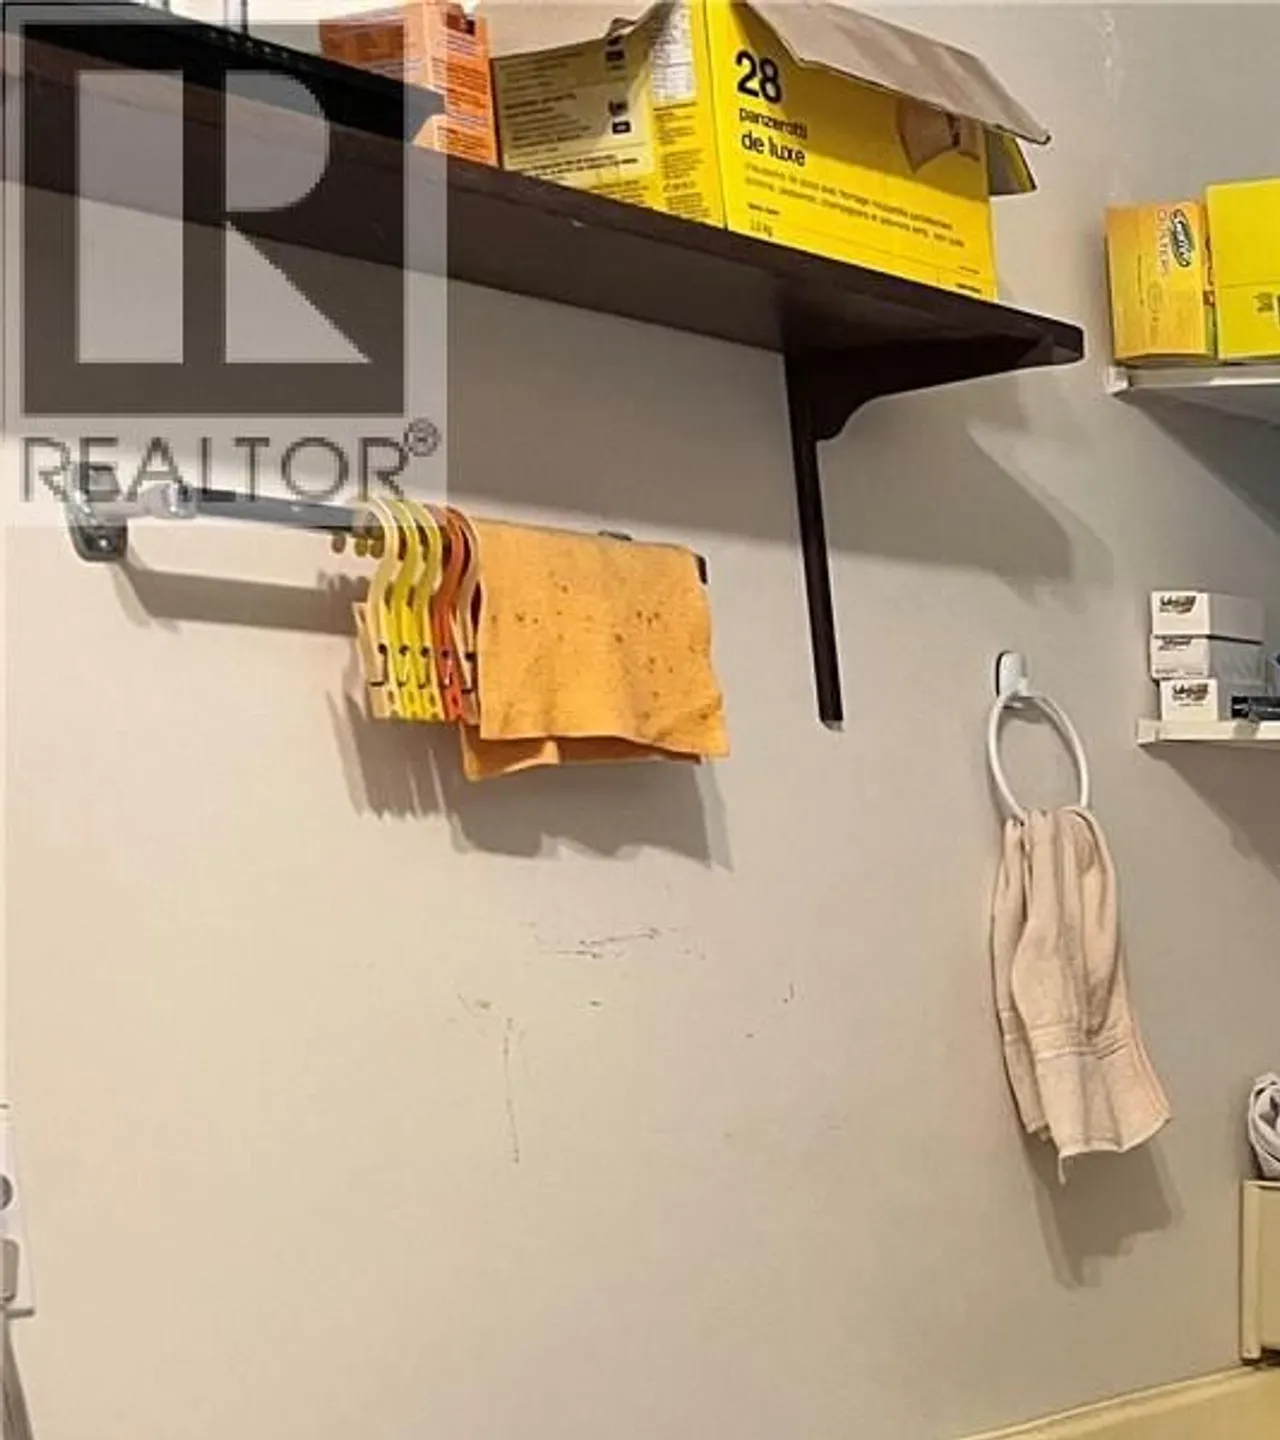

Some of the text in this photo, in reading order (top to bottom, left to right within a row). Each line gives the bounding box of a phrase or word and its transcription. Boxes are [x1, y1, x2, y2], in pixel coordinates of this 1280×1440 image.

[735, 50, 783, 105] 28
[741, 131, 806, 167] de luxe
